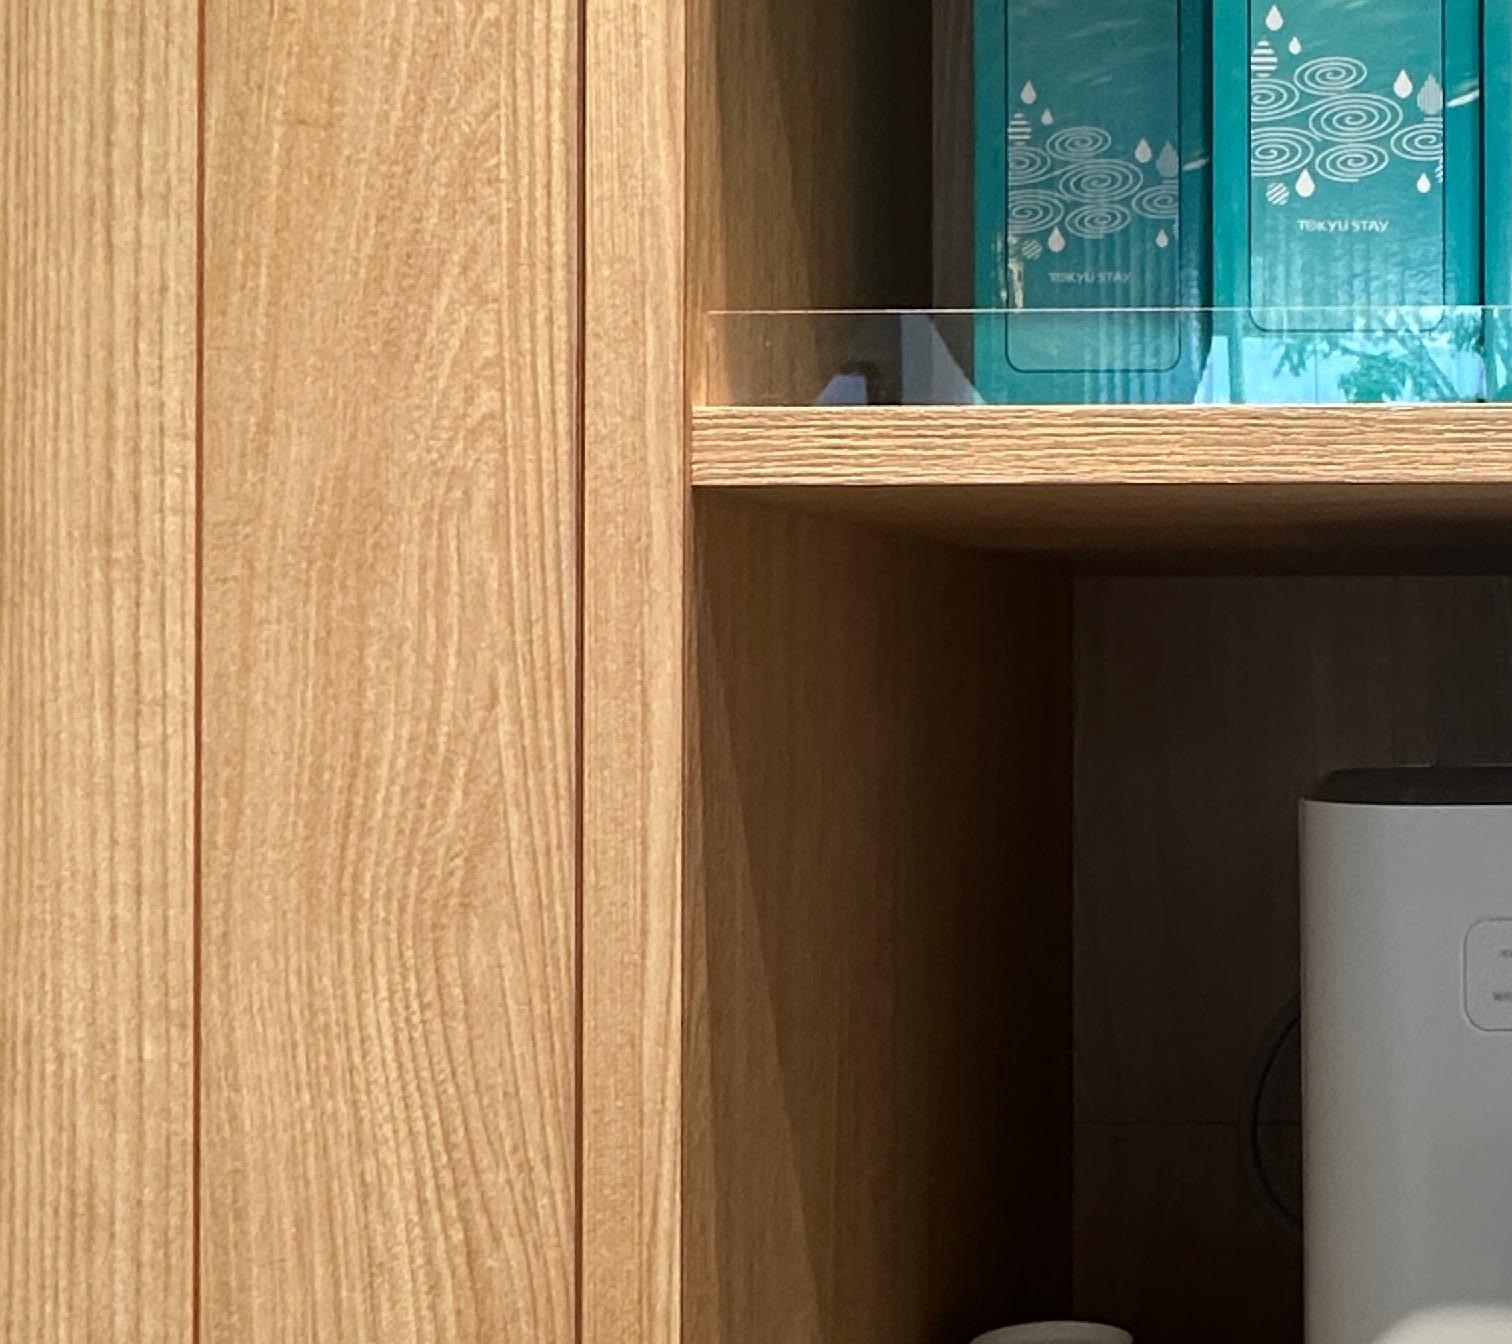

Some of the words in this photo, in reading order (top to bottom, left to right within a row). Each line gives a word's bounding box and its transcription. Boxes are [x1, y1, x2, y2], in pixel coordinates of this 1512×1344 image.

[1297, 219, 1348, 233] TOKYU
[1350, 219, 1390, 233] STAY
[1049, 271, 1095, 284] TOKYU
[1097, 271, 1132, 284] STAY
